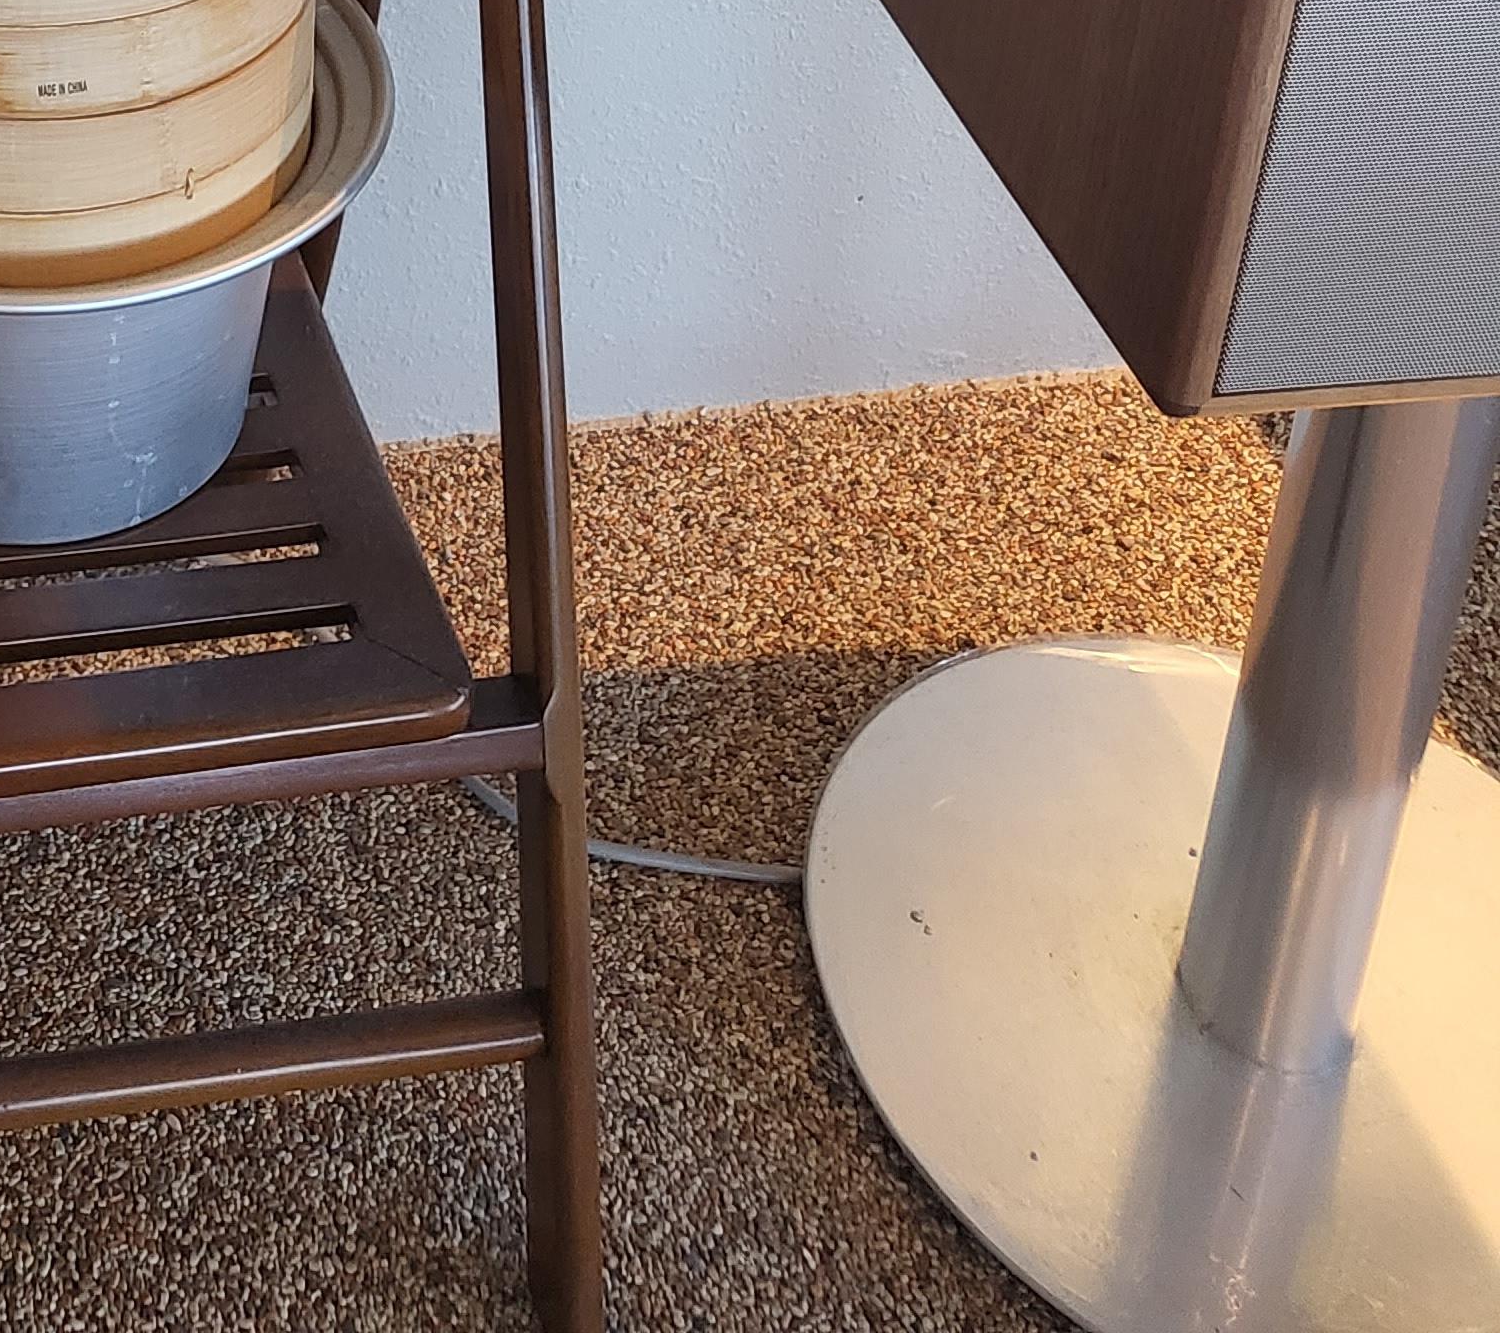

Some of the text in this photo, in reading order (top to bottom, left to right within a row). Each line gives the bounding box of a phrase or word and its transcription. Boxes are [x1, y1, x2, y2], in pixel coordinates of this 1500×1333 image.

[37, 80, 88, 97] MADE IN CHINA
